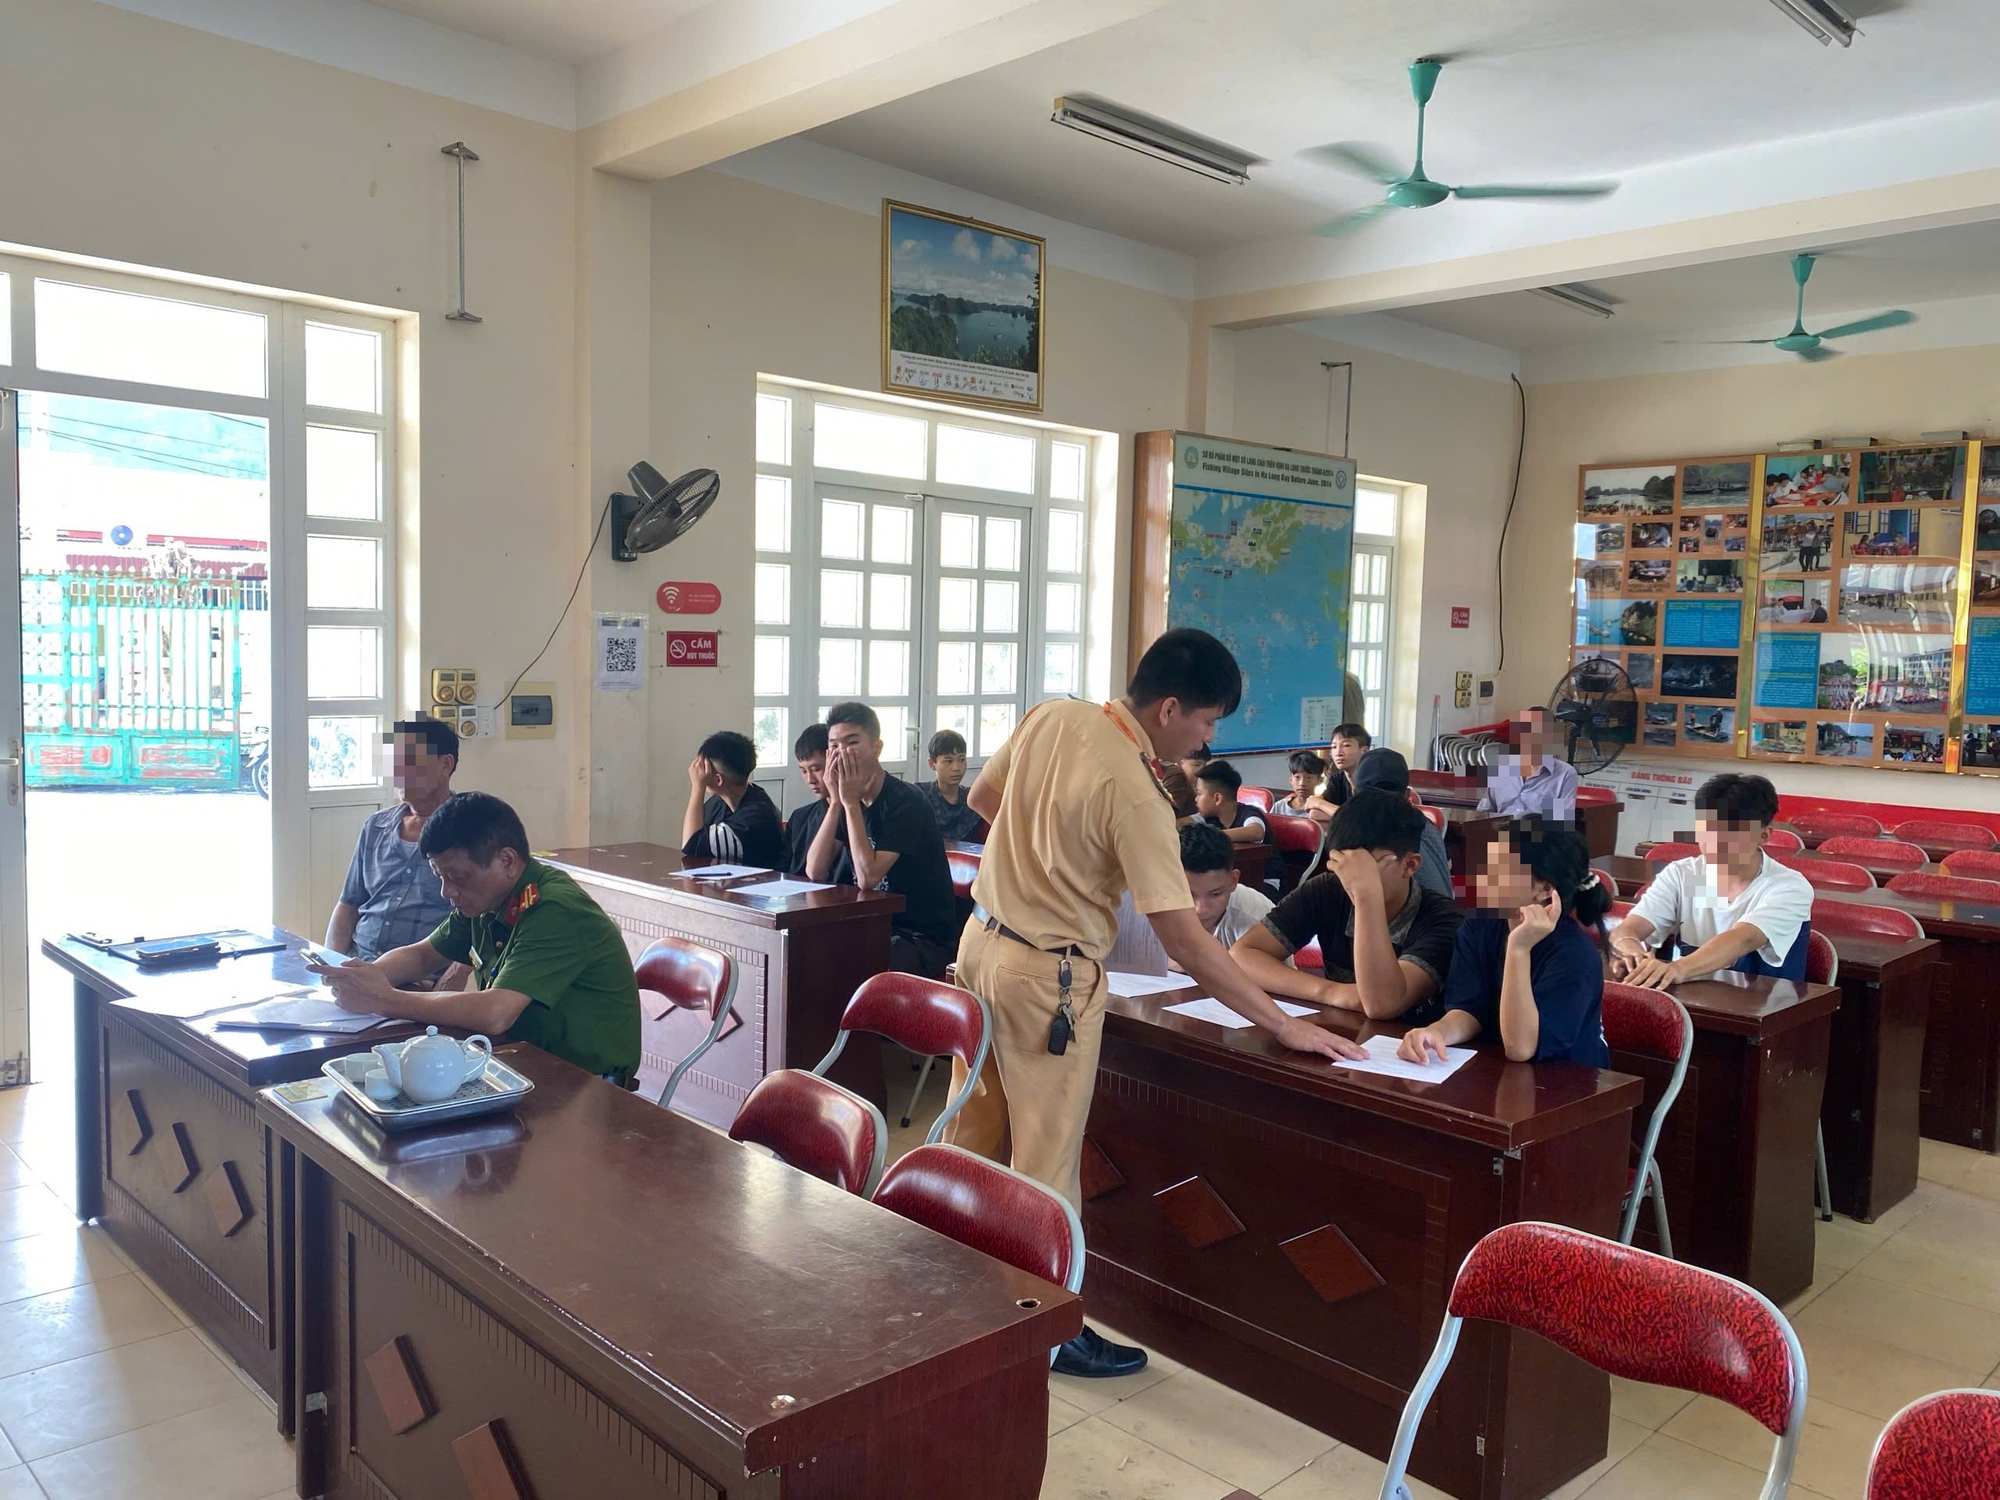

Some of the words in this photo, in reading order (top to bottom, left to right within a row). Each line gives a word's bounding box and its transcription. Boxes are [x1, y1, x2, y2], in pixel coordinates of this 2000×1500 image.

[1203, 462, 1221, 473] Fishing
[1223, 464, 1240, 475] Village
[1241, 467, 1254, 477] Sites
[1261, 470, 1267, 479] Ha
[1269, 472, 1280, 481] Long
[1281, 474, 1290, 482] Bay
[1291, 475, 1306, 484] Before
[1321, 479, 1332, 488] 2014
[690, 638, 712, 649] CẤM
